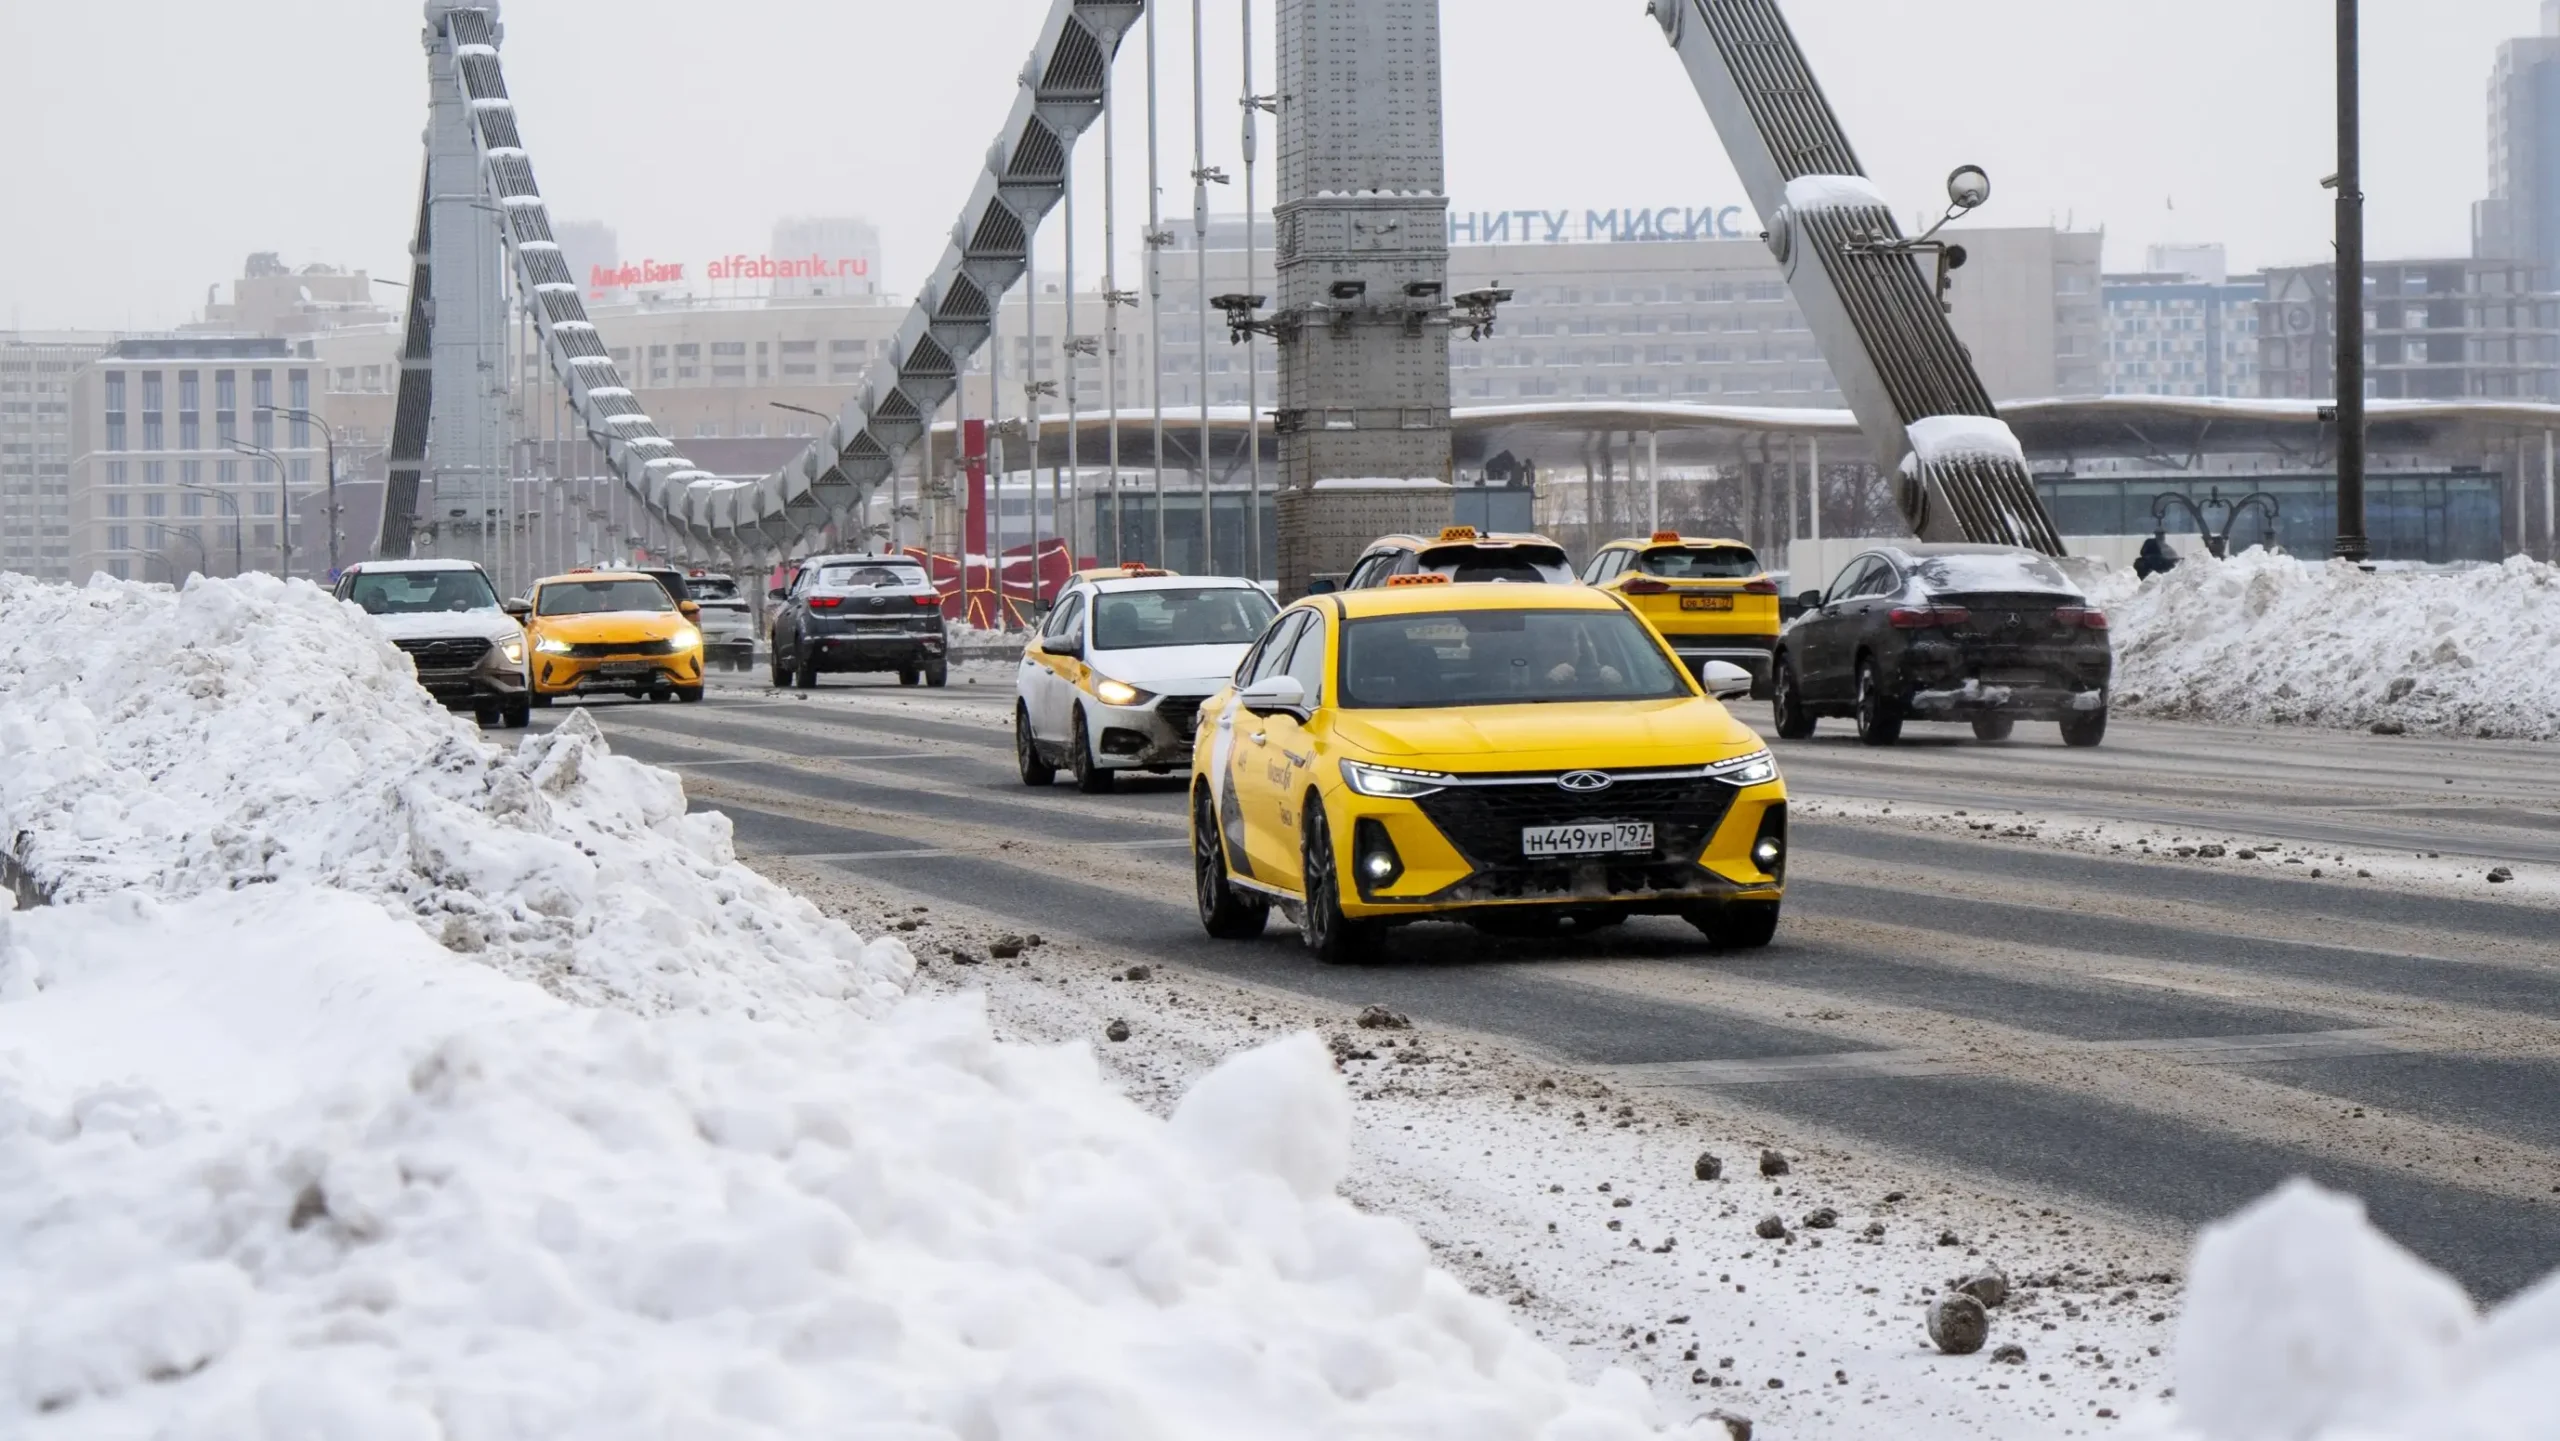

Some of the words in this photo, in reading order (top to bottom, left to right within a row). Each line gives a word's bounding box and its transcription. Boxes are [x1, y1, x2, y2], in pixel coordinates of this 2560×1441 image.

[1450, 209, 1569, 243] НИТУ
[1586, 205, 1742, 241] МИСИС
[707, 253, 868, 279] alfabank.ru
[1530, 828, 1613, 851] Н449УР
[1617, 825, 1649, 842] 797
